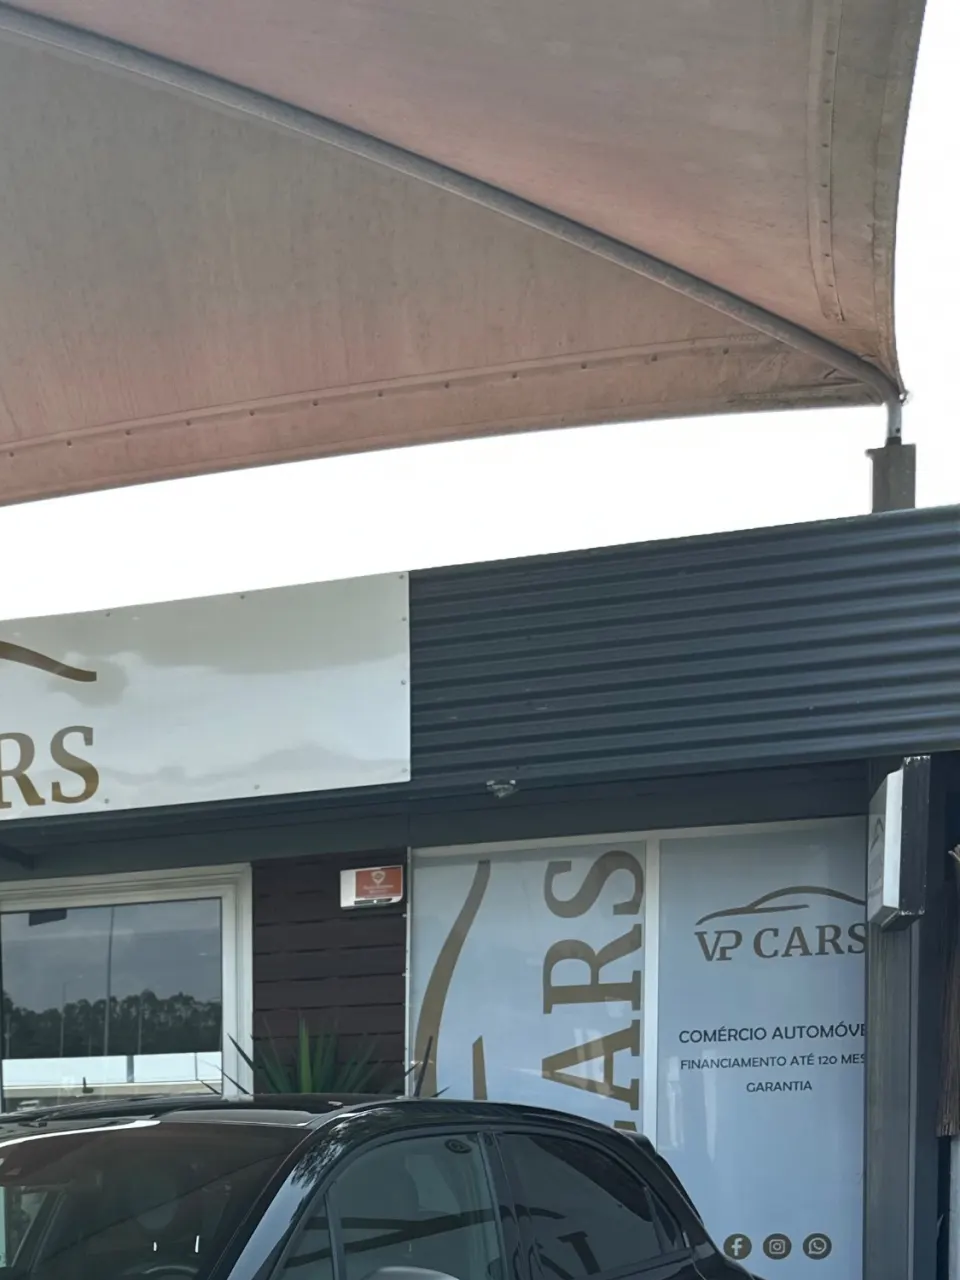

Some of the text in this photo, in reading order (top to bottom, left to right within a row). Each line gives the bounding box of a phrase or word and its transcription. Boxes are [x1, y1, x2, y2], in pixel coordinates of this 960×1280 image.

[694, 922, 866, 962] VP CARS
[541, 850, 644, 1131] ARS
[679, 1025, 767, 1044] COMÉRCIO
[680, 1055, 787, 1070] FINANCIAMENTO
[790, 1053, 815, 1067] ATÉ
[818, 1055, 838, 1065] 120
[746, 1080, 813, 1093] GARANTIA
